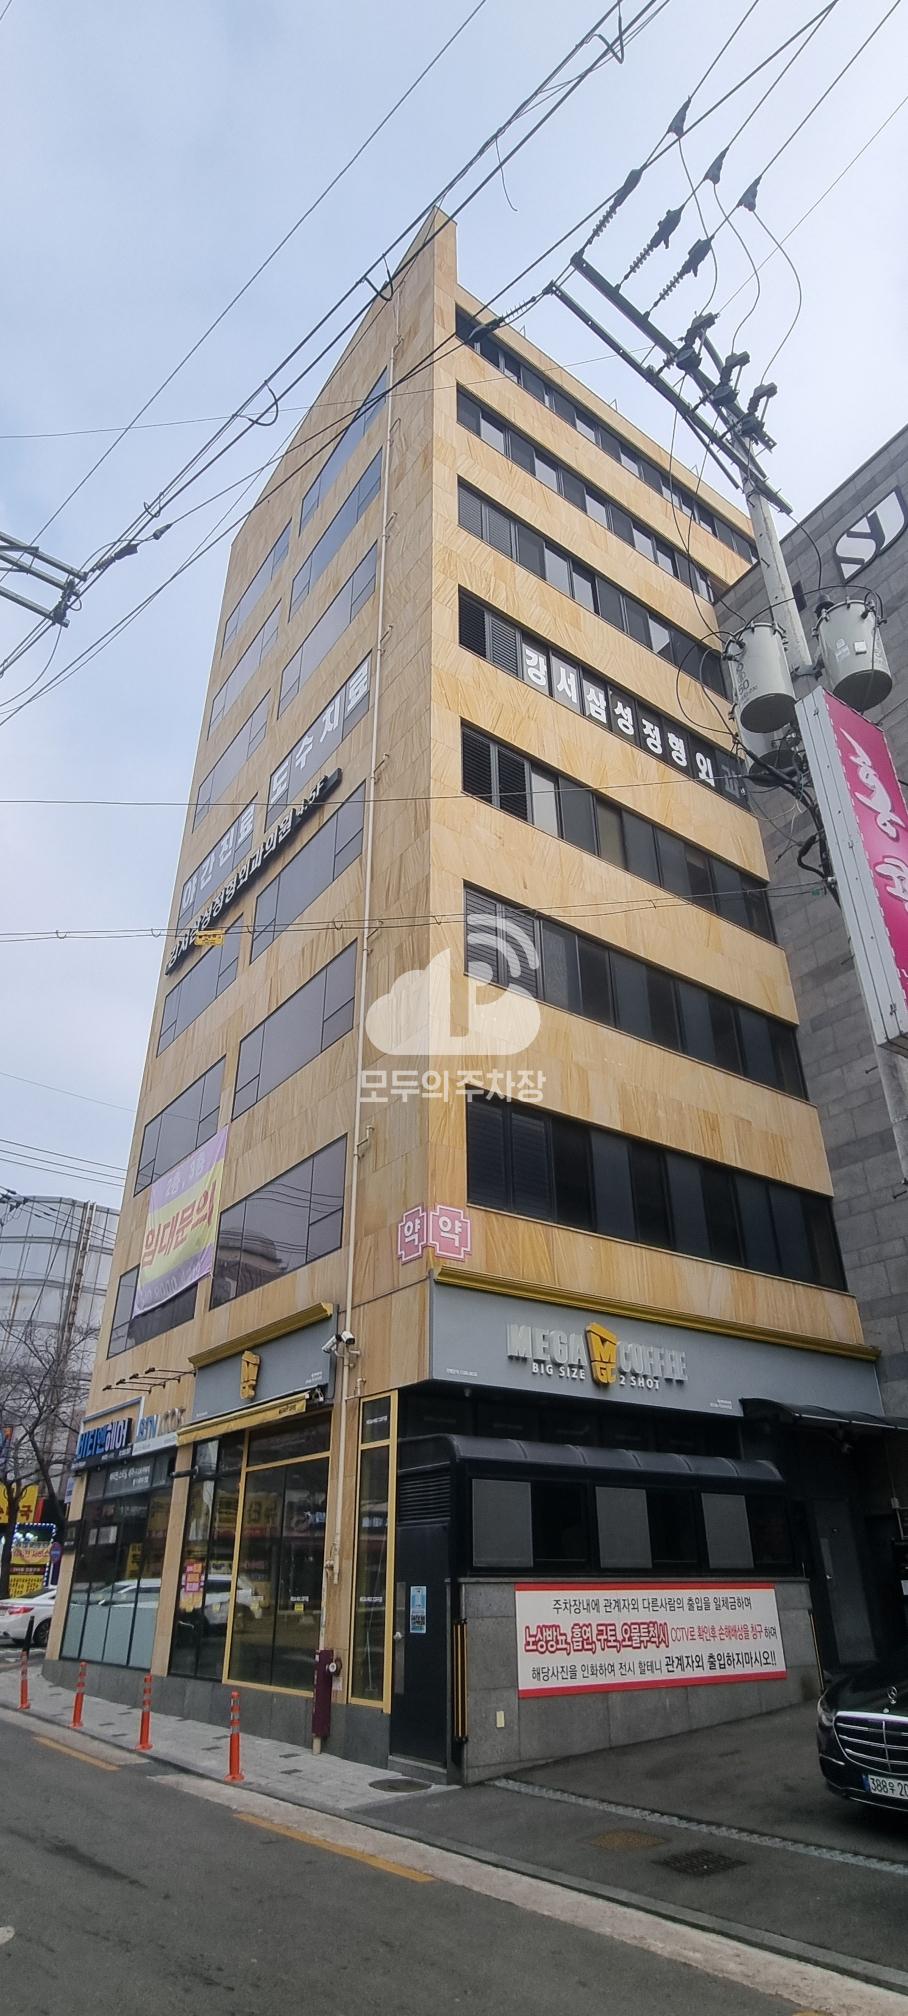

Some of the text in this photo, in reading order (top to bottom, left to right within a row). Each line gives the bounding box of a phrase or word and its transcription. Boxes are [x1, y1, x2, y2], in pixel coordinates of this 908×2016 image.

[268, 661, 370, 806] 도수치료
[181, 804, 256, 908] 야간진료
[141, 1179, 217, 1268] 임대문의
[404, 1218, 421, 1246] 약
[439, 1216, 462, 1247] 약
[507, 1324, 687, 1380] MEGA COFFEE
[532, 1362, 659, 1389] BIG SIZE 2 SHOT
[553, 1596, 752, 1614] 주차장내에 관계자외 다른사람의 출입을 일체금하며
[525, 1625, 571, 1655] 노상방뇨,
[571, 1623, 596, 1654] 흡연,
[597, 1623, 621, 1653] 구토,
[621, 1621, 669, 1649] 오물투척시
[671, 1626, 696, 1642] CCTV로
[697, 1625, 717, 1641] 확인후
[719, 1624, 750, 1640] 손해배상을
[764, 1626, 778, 1639] 하며
[531, 1650, 776, 1681] 해당사진을 인화하여 전시 할테니 관계자외 출입하지마시오!!
